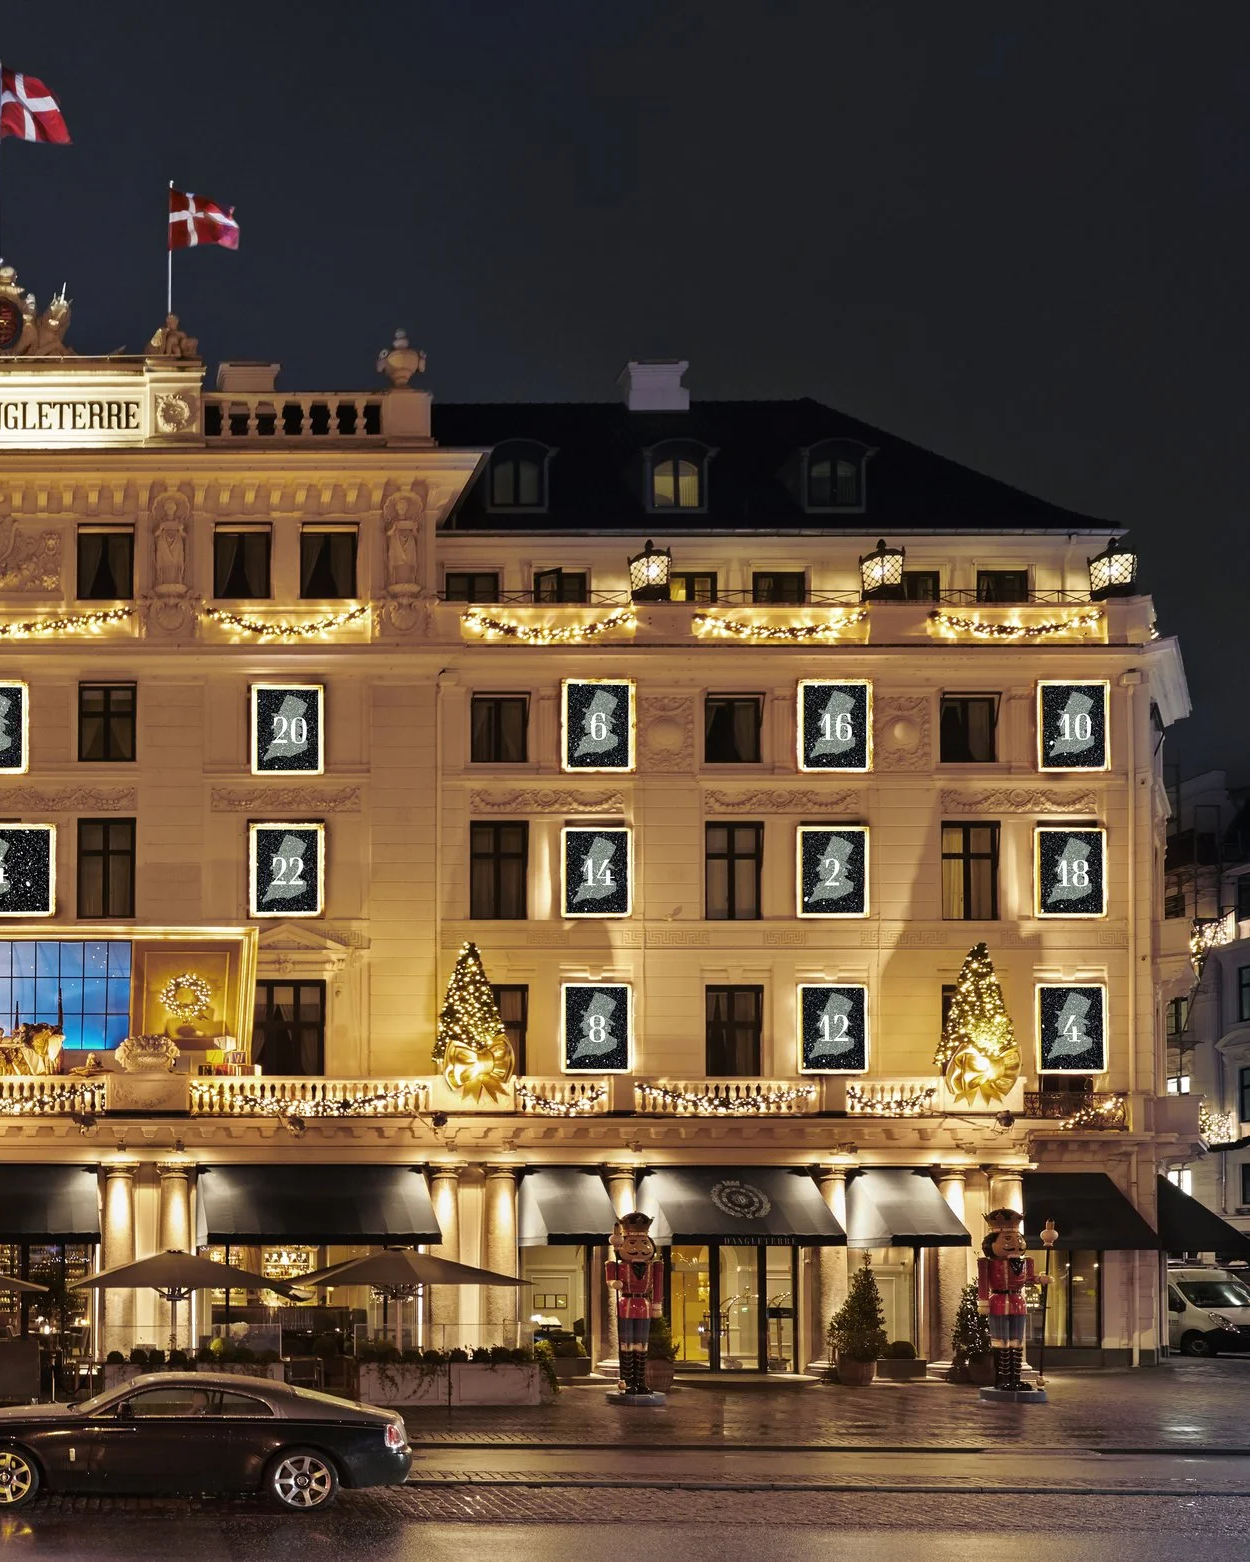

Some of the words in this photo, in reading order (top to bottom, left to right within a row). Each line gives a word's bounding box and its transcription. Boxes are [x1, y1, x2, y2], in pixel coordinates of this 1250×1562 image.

[273, 715, 308, 745] 20
[589, 711, 608, 741] 6
[820, 712, 853, 742] 16
[1059, 712, 1092, 743] 10
[270, 856, 304, 885] 22
[583, 857, 615, 887] 14
[824, 857, 841, 887] 2
[1057, 859, 1089, 888] 18
[588, 1014, 607, 1043] 8
[819, 1012, 849, 1042] 12
[1062, 1014, 1082, 1043] 4
